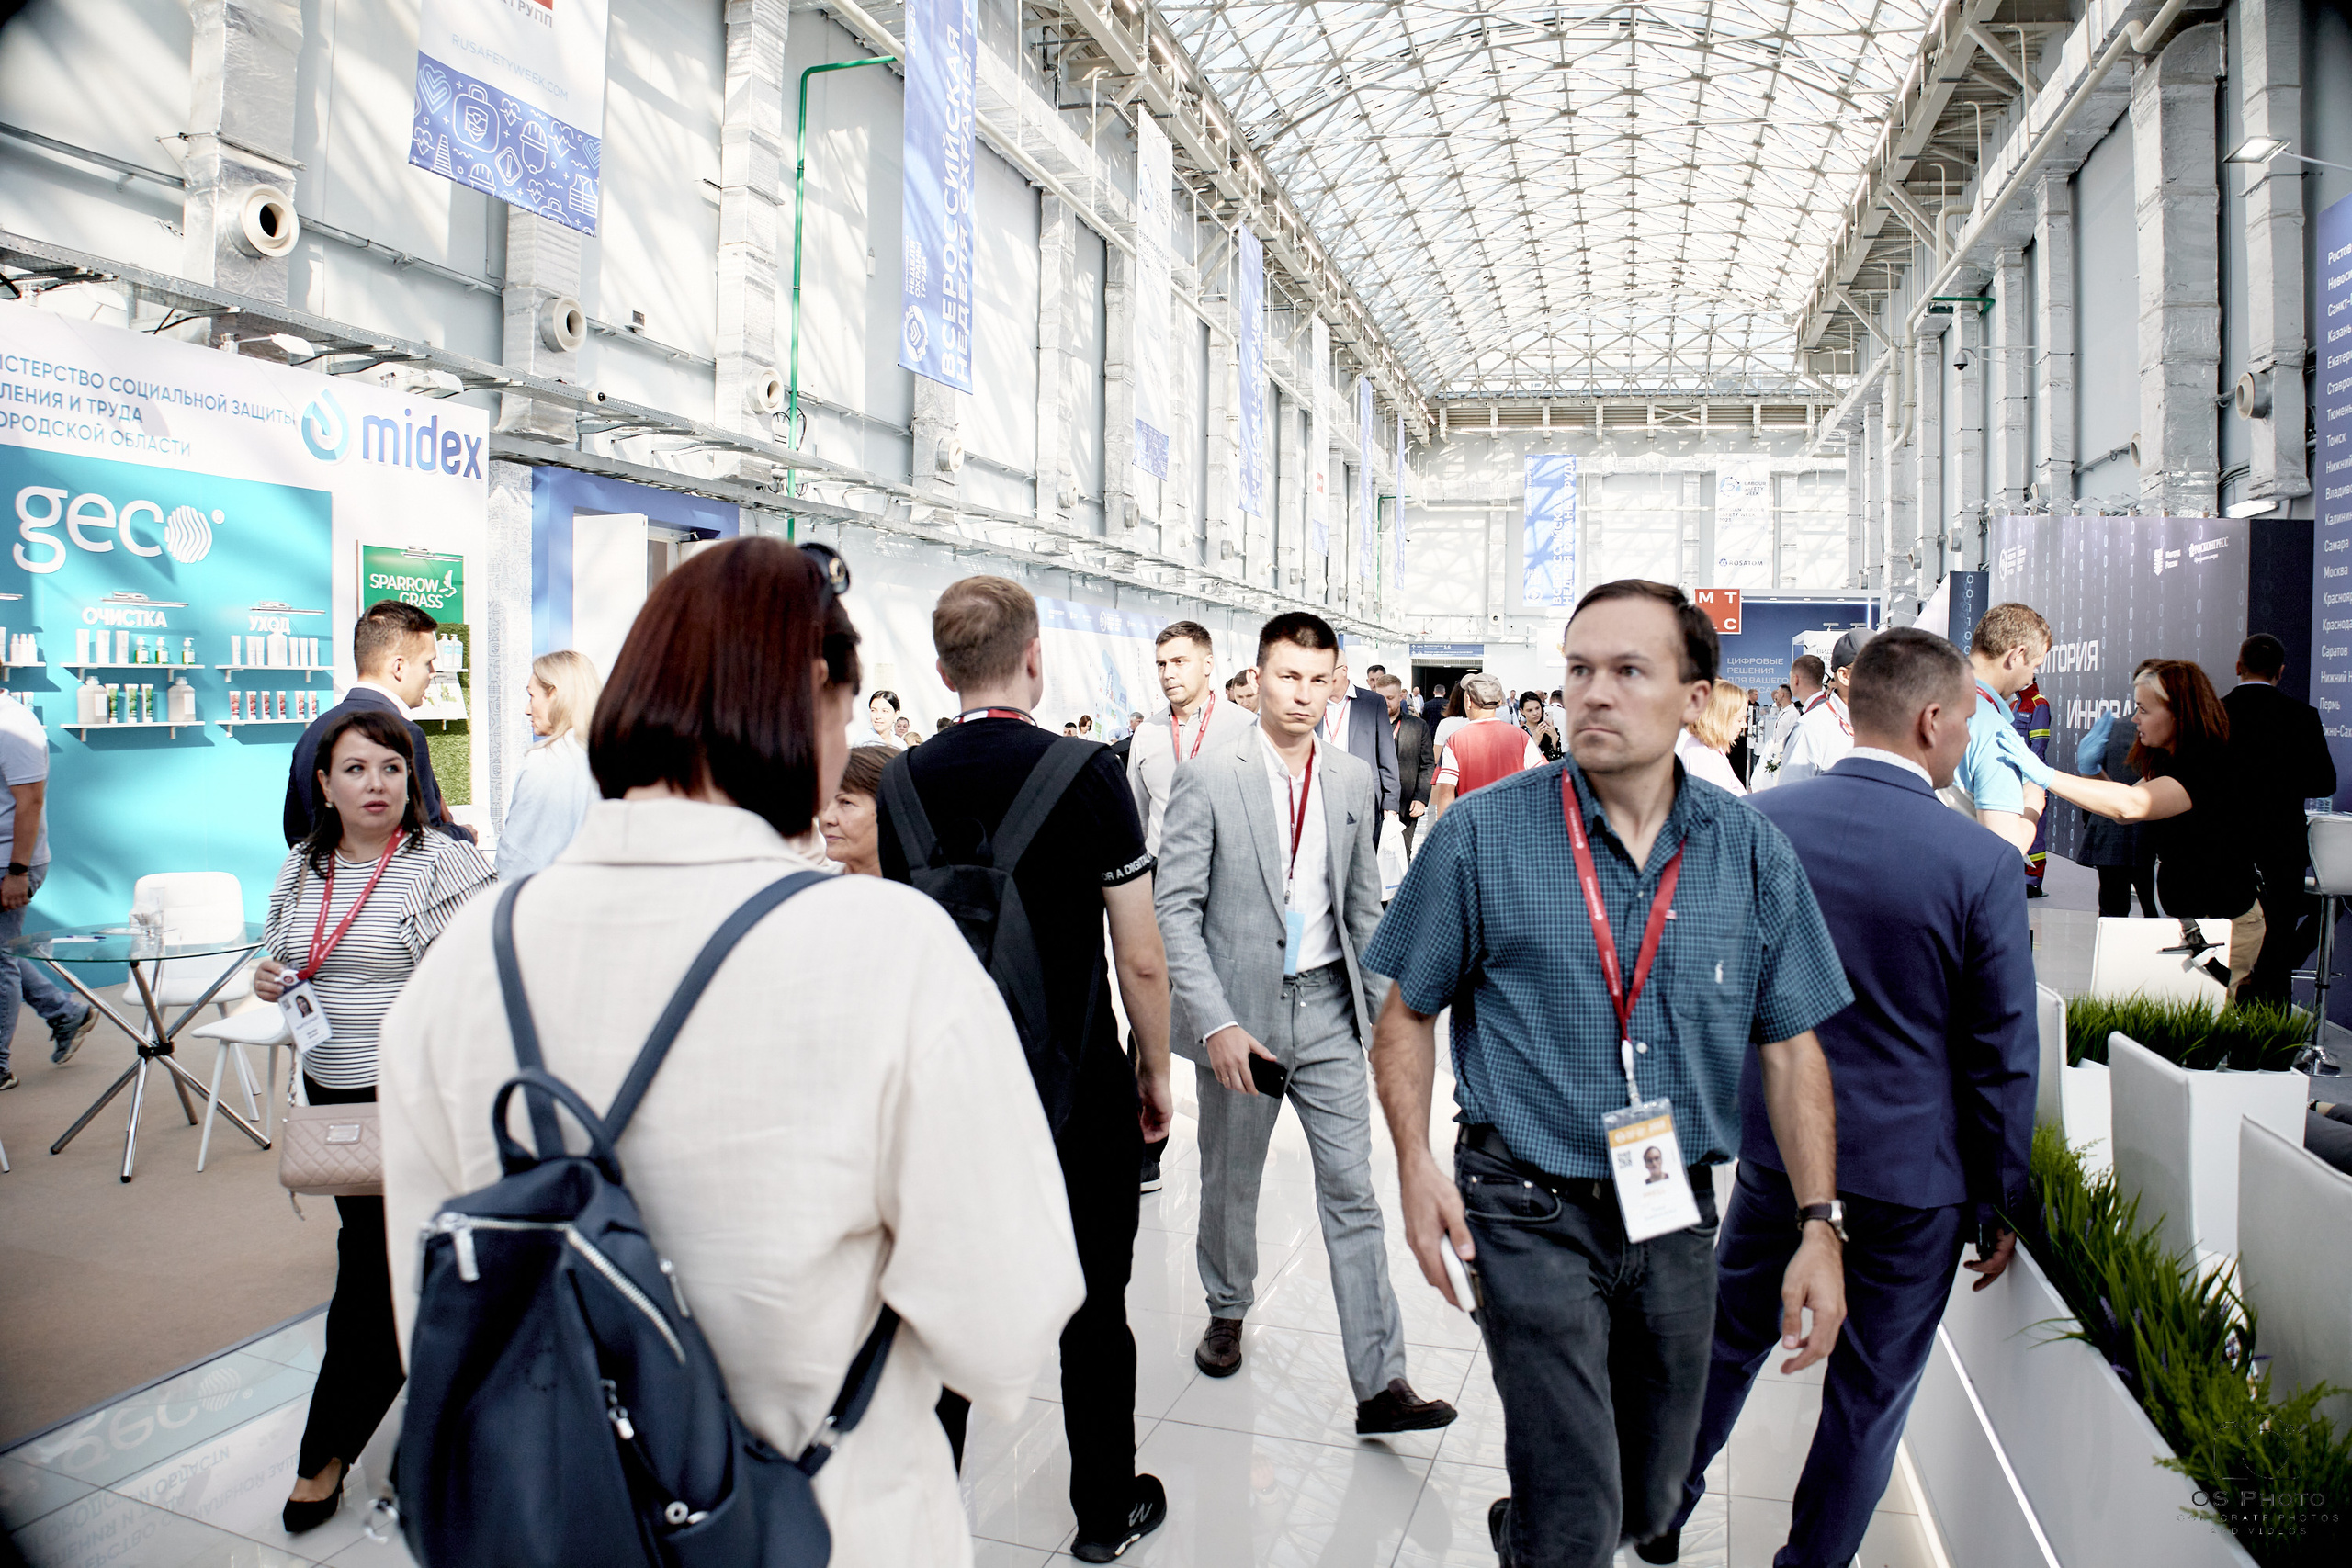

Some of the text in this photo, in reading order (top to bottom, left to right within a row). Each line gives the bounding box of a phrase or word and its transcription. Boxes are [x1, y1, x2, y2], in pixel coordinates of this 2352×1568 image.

[451, 33, 569, 102] RUSAFETYWEEK.COM
[959, 53, 972, 214] ОХРАНЫ
[941, 23, 961, 378] ВСЕРОССИЙСКАЯ
[957, 224, 971, 384] НЕДЕЛЯ
[2327, 323, 2352, 344] Казань
[69, 395, 81, 412] И
[87, 398, 143, 423] ТРУДА
[109, 377, 227, 413] СОЦИАЛЬНОЙ
[232, 400, 296, 426] ЗАЩИТЫ
[110, 430, 191, 457] ОБЛАСТИ
[363, 408, 482, 480] midex
[2326, 432, 2346, 448] Томск
[1563, 496, 1574, 552] ОХРАНЫ
[1551, 495, 1563, 604] ВСЕРОССИЙСКАЯ
[2324, 537, 2350, 553] Самара
[369, 573, 439, 593] SPARROW
[1563, 555, 1574, 604] НЕДЕЛЯ
[2324, 566, 2348, 579] Москва
[82, 606, 168, 628] ОЧИСТКА
[249, 615, 291, 635] УХОД
[1726, 658, 1783, 666] ЦИФРОВЫЕ
[2321, 644, 2348, 660] Саратов
[2320, 670, 2347, 684] Нижний
[2319, 697, 2341, 712] Пермь
[1115, 868, 1125, 879] A
